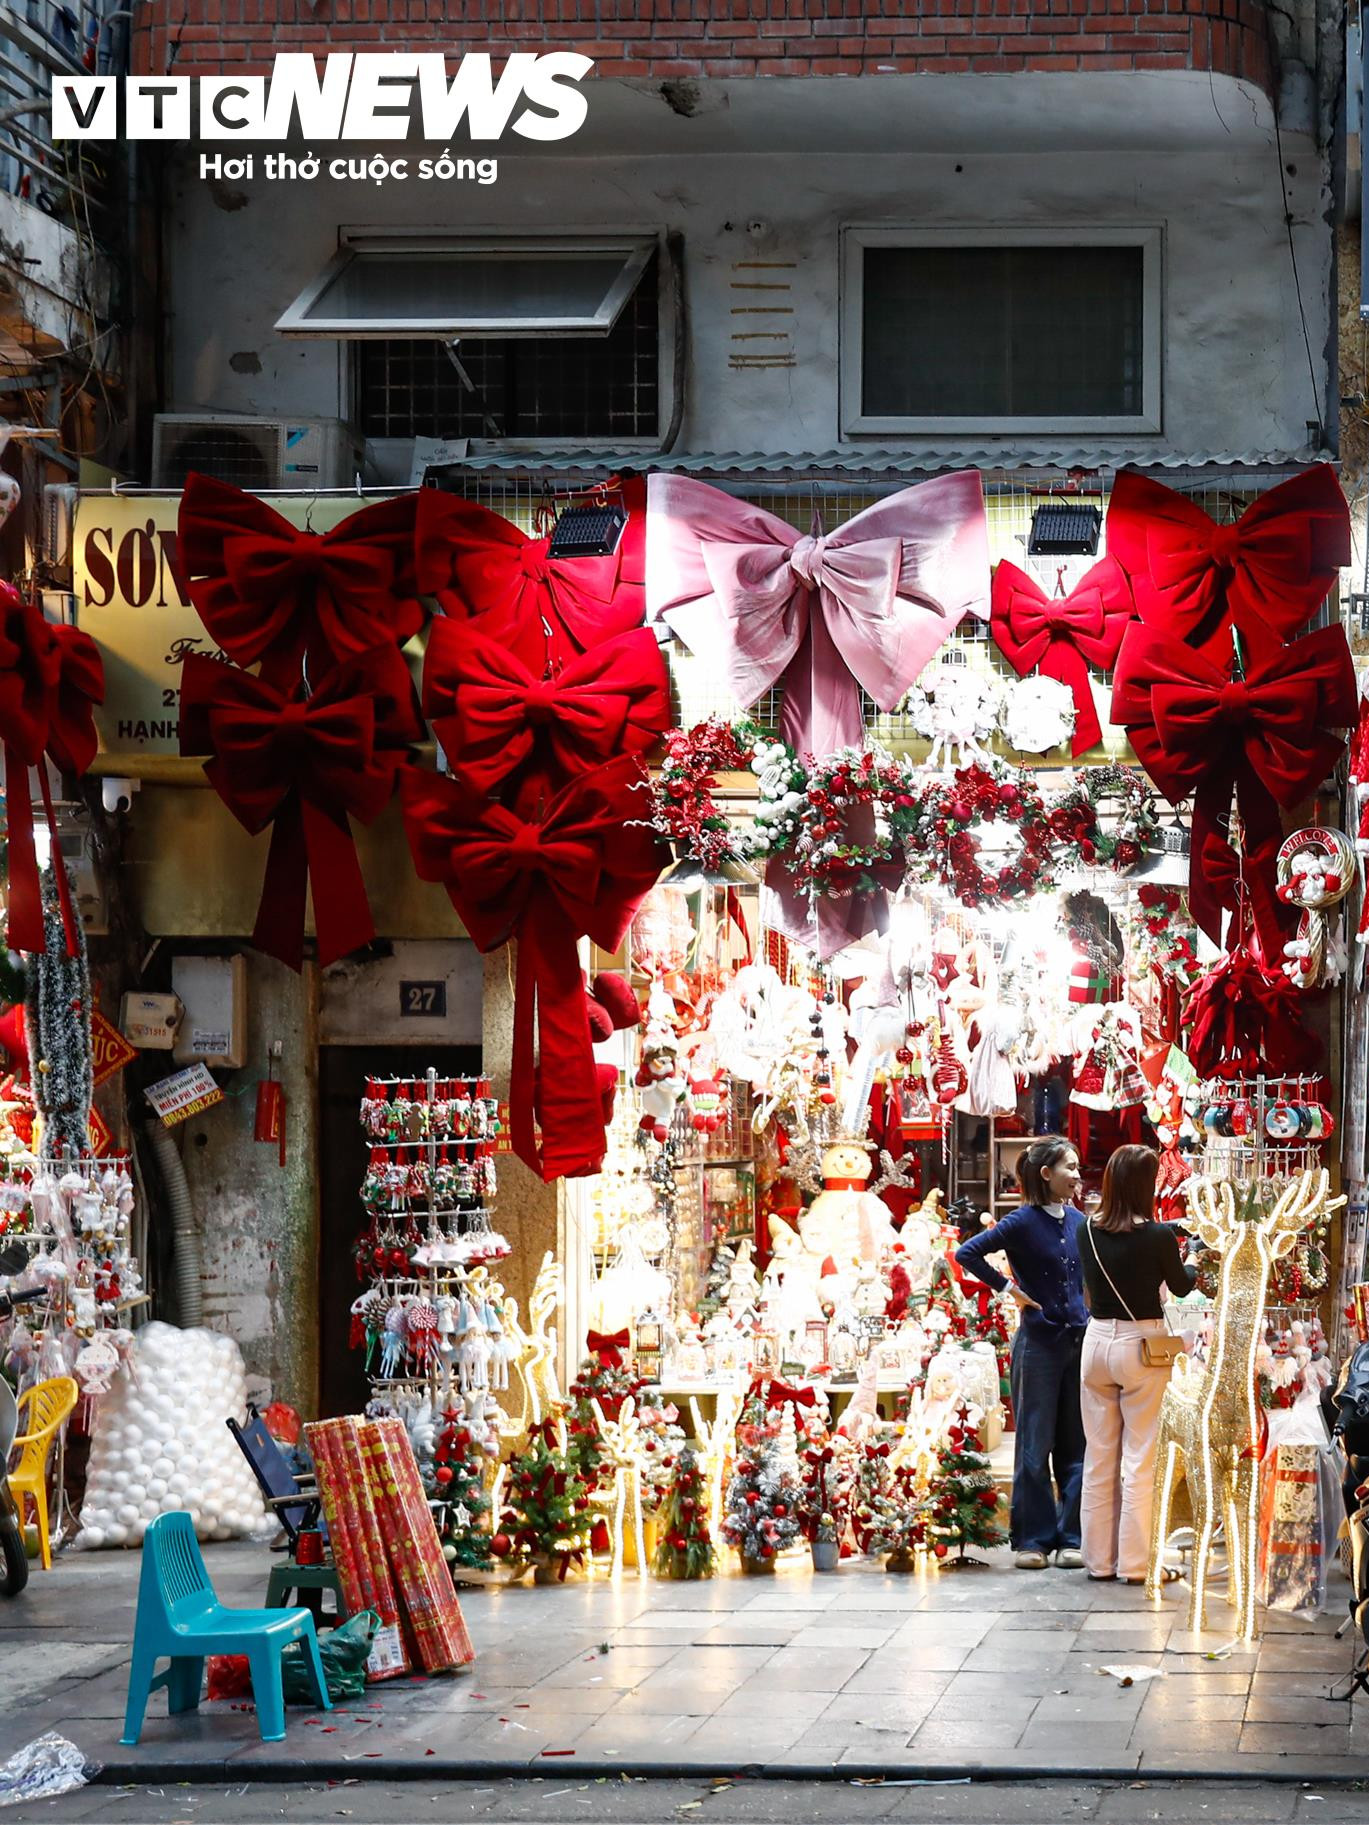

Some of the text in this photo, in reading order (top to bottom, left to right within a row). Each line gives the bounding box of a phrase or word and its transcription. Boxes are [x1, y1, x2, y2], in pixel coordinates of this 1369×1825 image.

[84, 518, 191, 607] SƠN
[1282, 830, 1336, 855] WELCOME
[408, 987, 436, 1010] 27
[192, 1080, 213, 1095] 100%
